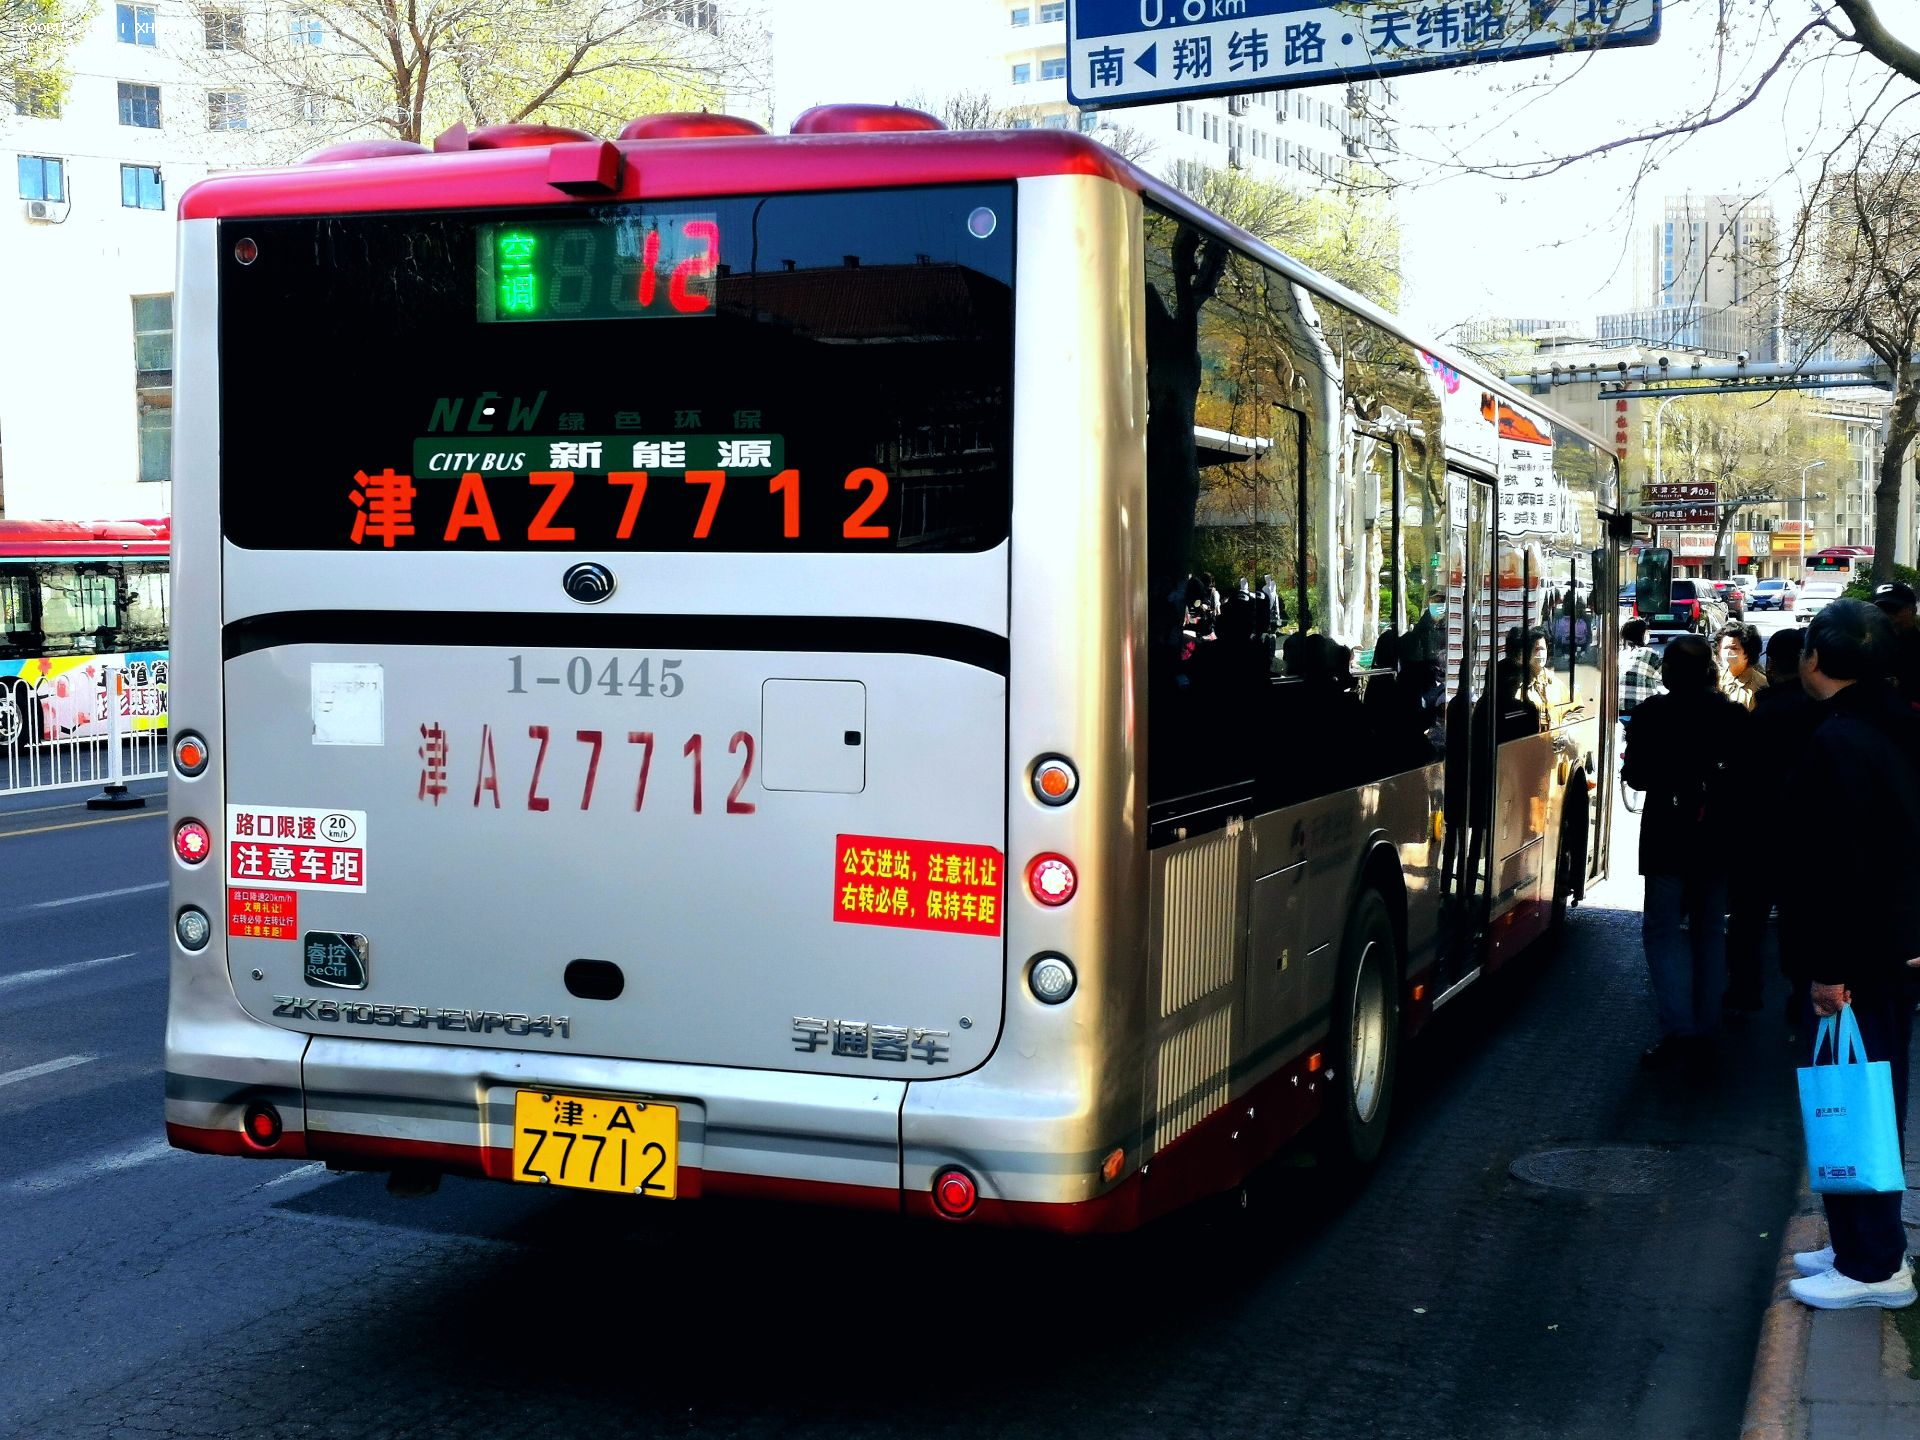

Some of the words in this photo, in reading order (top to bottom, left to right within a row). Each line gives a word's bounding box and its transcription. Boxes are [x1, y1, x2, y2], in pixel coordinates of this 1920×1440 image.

[1088, 45, 1125, 89] 南
[501, 232, 535, 311] 空调
[639, 220, 720, 313] 12
[558, 410, 762, 431] 绿色环保
[428, 452, 476, 471] CITY
[482, 452, 527, 471] BUS
[549, 441, 772, 469] 新能源
[348, 467, 890, 548] 津AZ7712
[507, 655, 685, 698] 1-0445
[418, 721, 756, 814] 津AZ7712
[236, 813, 316, 840] 路口限速
[329, 817, 346, 829] 20
[329, 830, 348, 838] km/h
[237, 845, 359, 882] 注意车距
[307, 943, 347, 966] 睿控
[307, 965, 347, 977] ReCtrl
[792, 1016, 950, 1065] 宇通客车
[522, 1128, 667, 1191] Z7712
